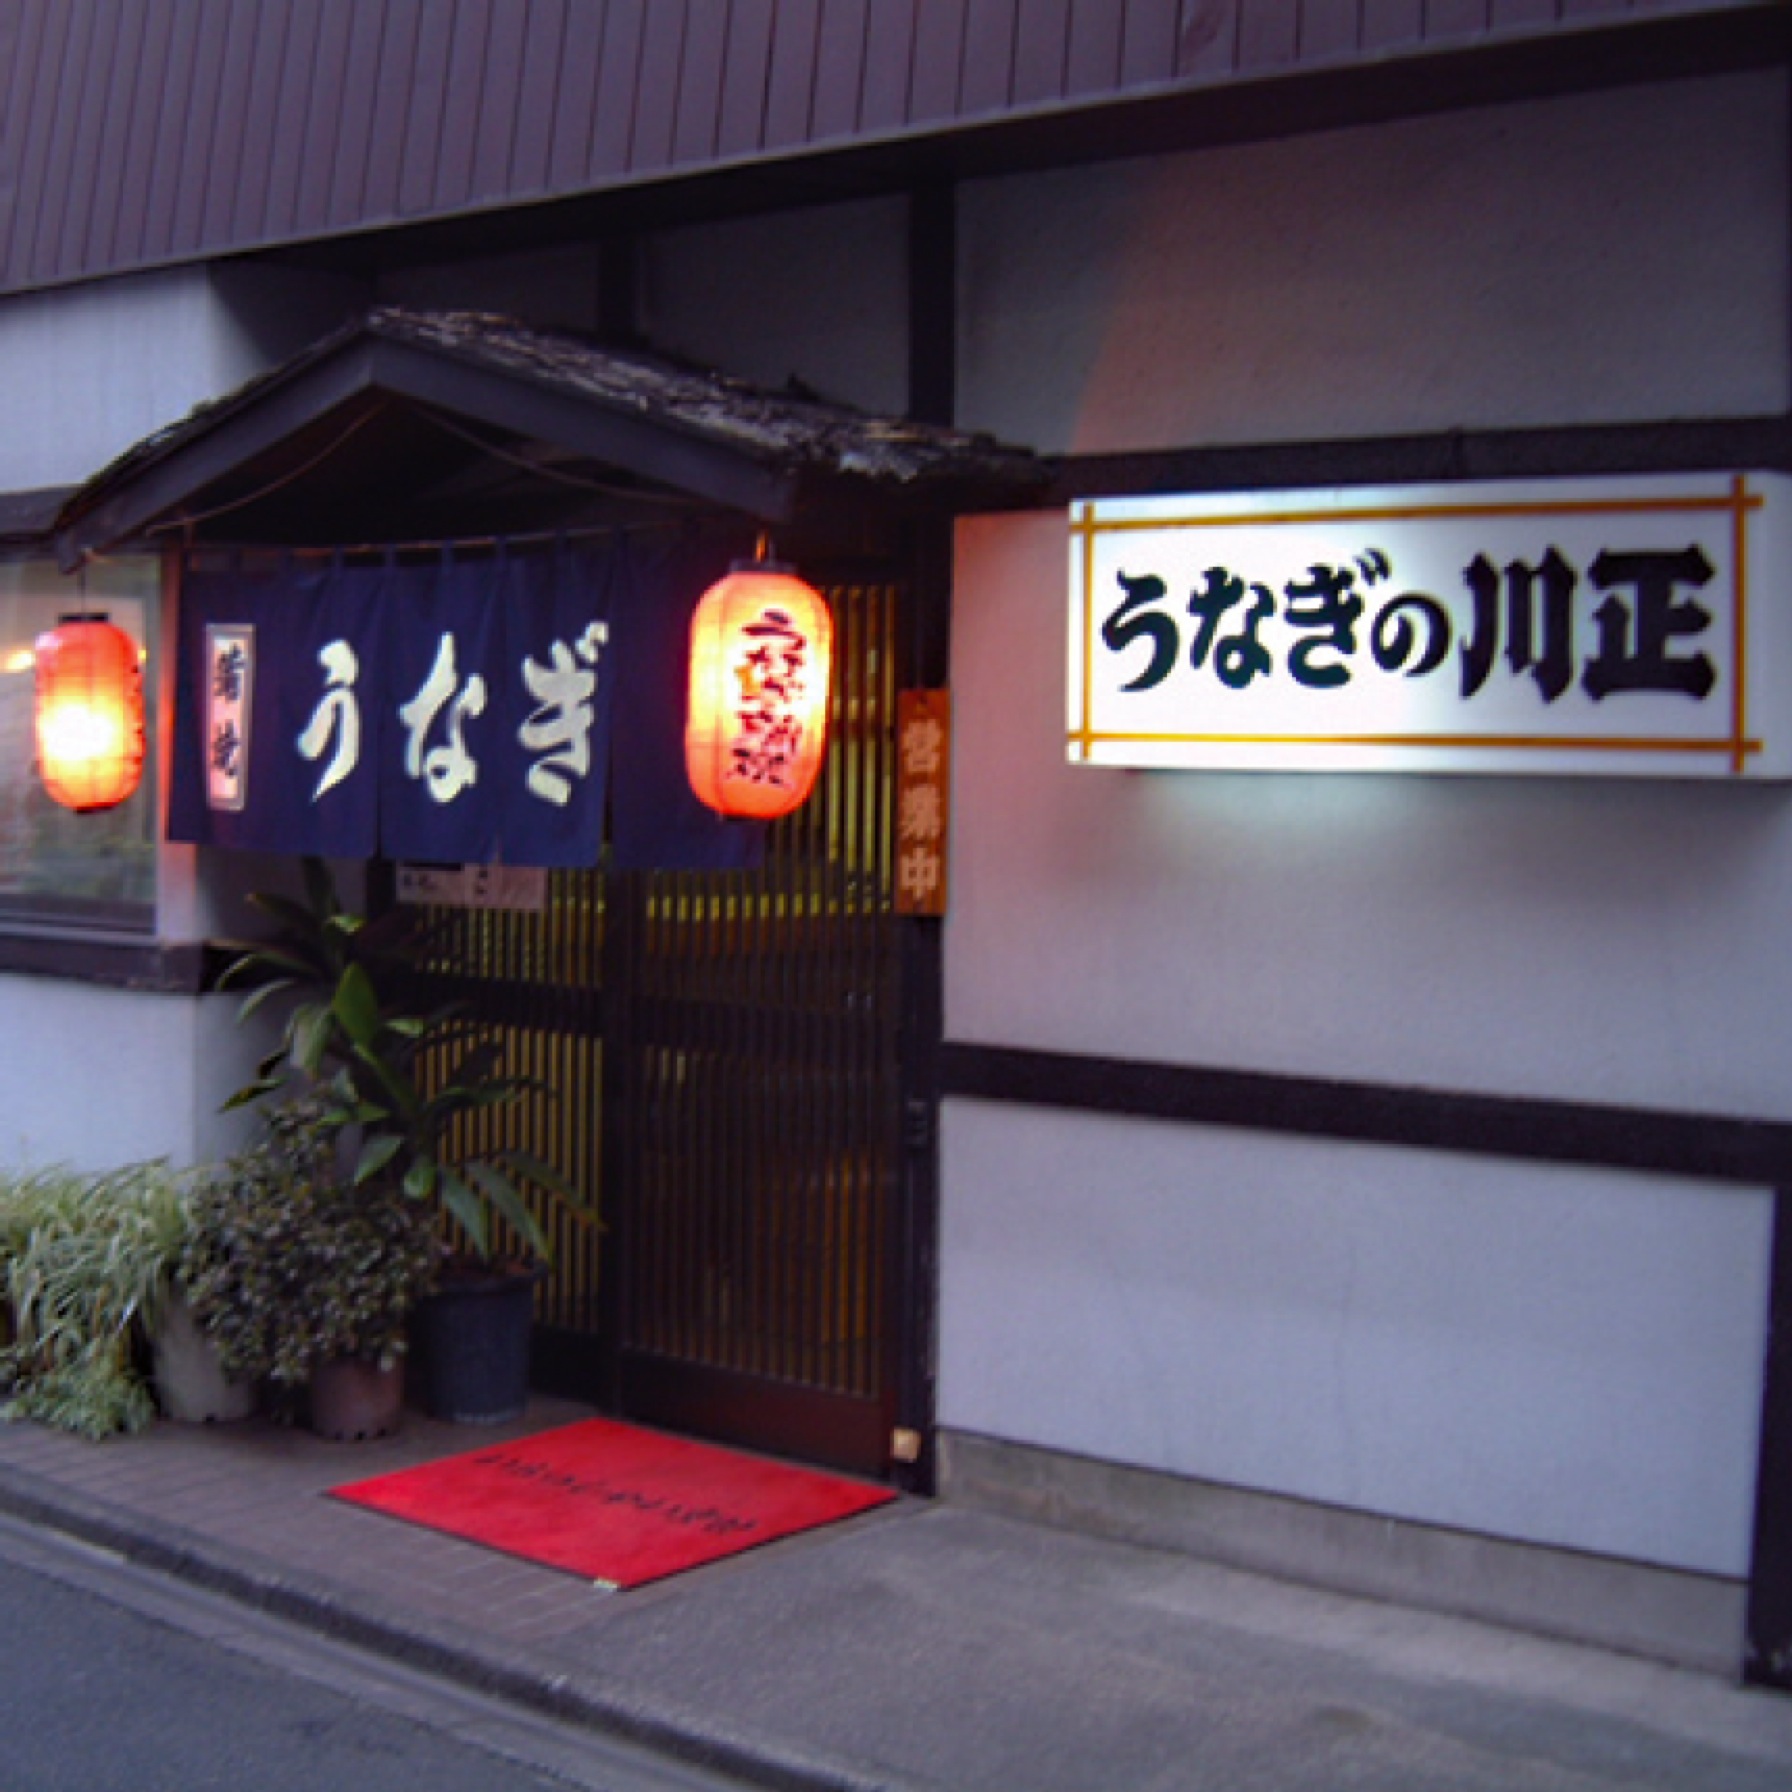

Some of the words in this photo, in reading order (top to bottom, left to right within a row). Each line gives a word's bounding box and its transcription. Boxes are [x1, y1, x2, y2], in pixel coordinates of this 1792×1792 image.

[1101, 544, 1716, 705] うなぎの川正
[296, 620, 609, 807] うなぎ
